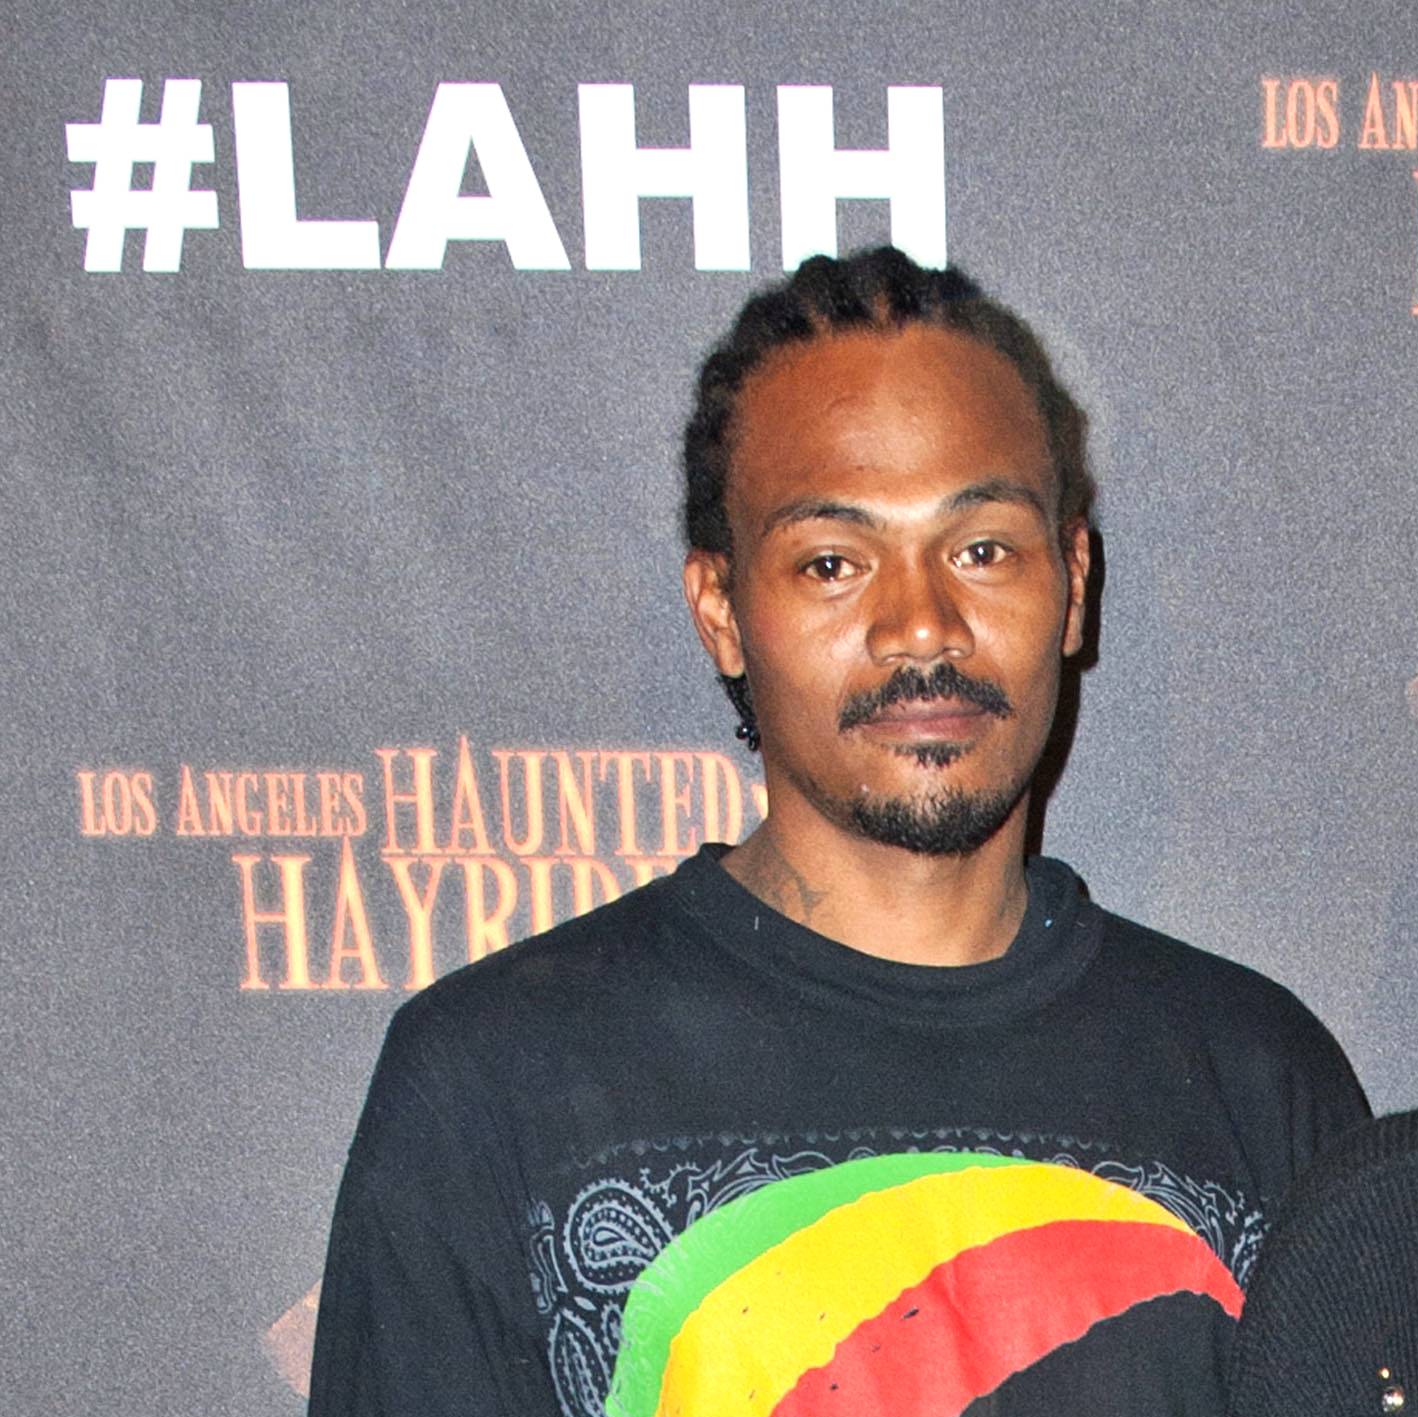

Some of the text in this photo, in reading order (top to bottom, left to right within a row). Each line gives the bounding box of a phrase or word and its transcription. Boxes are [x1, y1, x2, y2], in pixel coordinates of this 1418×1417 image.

[65, 78, 948, 273] #LAHH
[1262, 74, 1340, 149] LOS
[78, 733, 744, 857] LOS ANGELES HAUNTED
[231, 834, 672, 990] HAYRI
